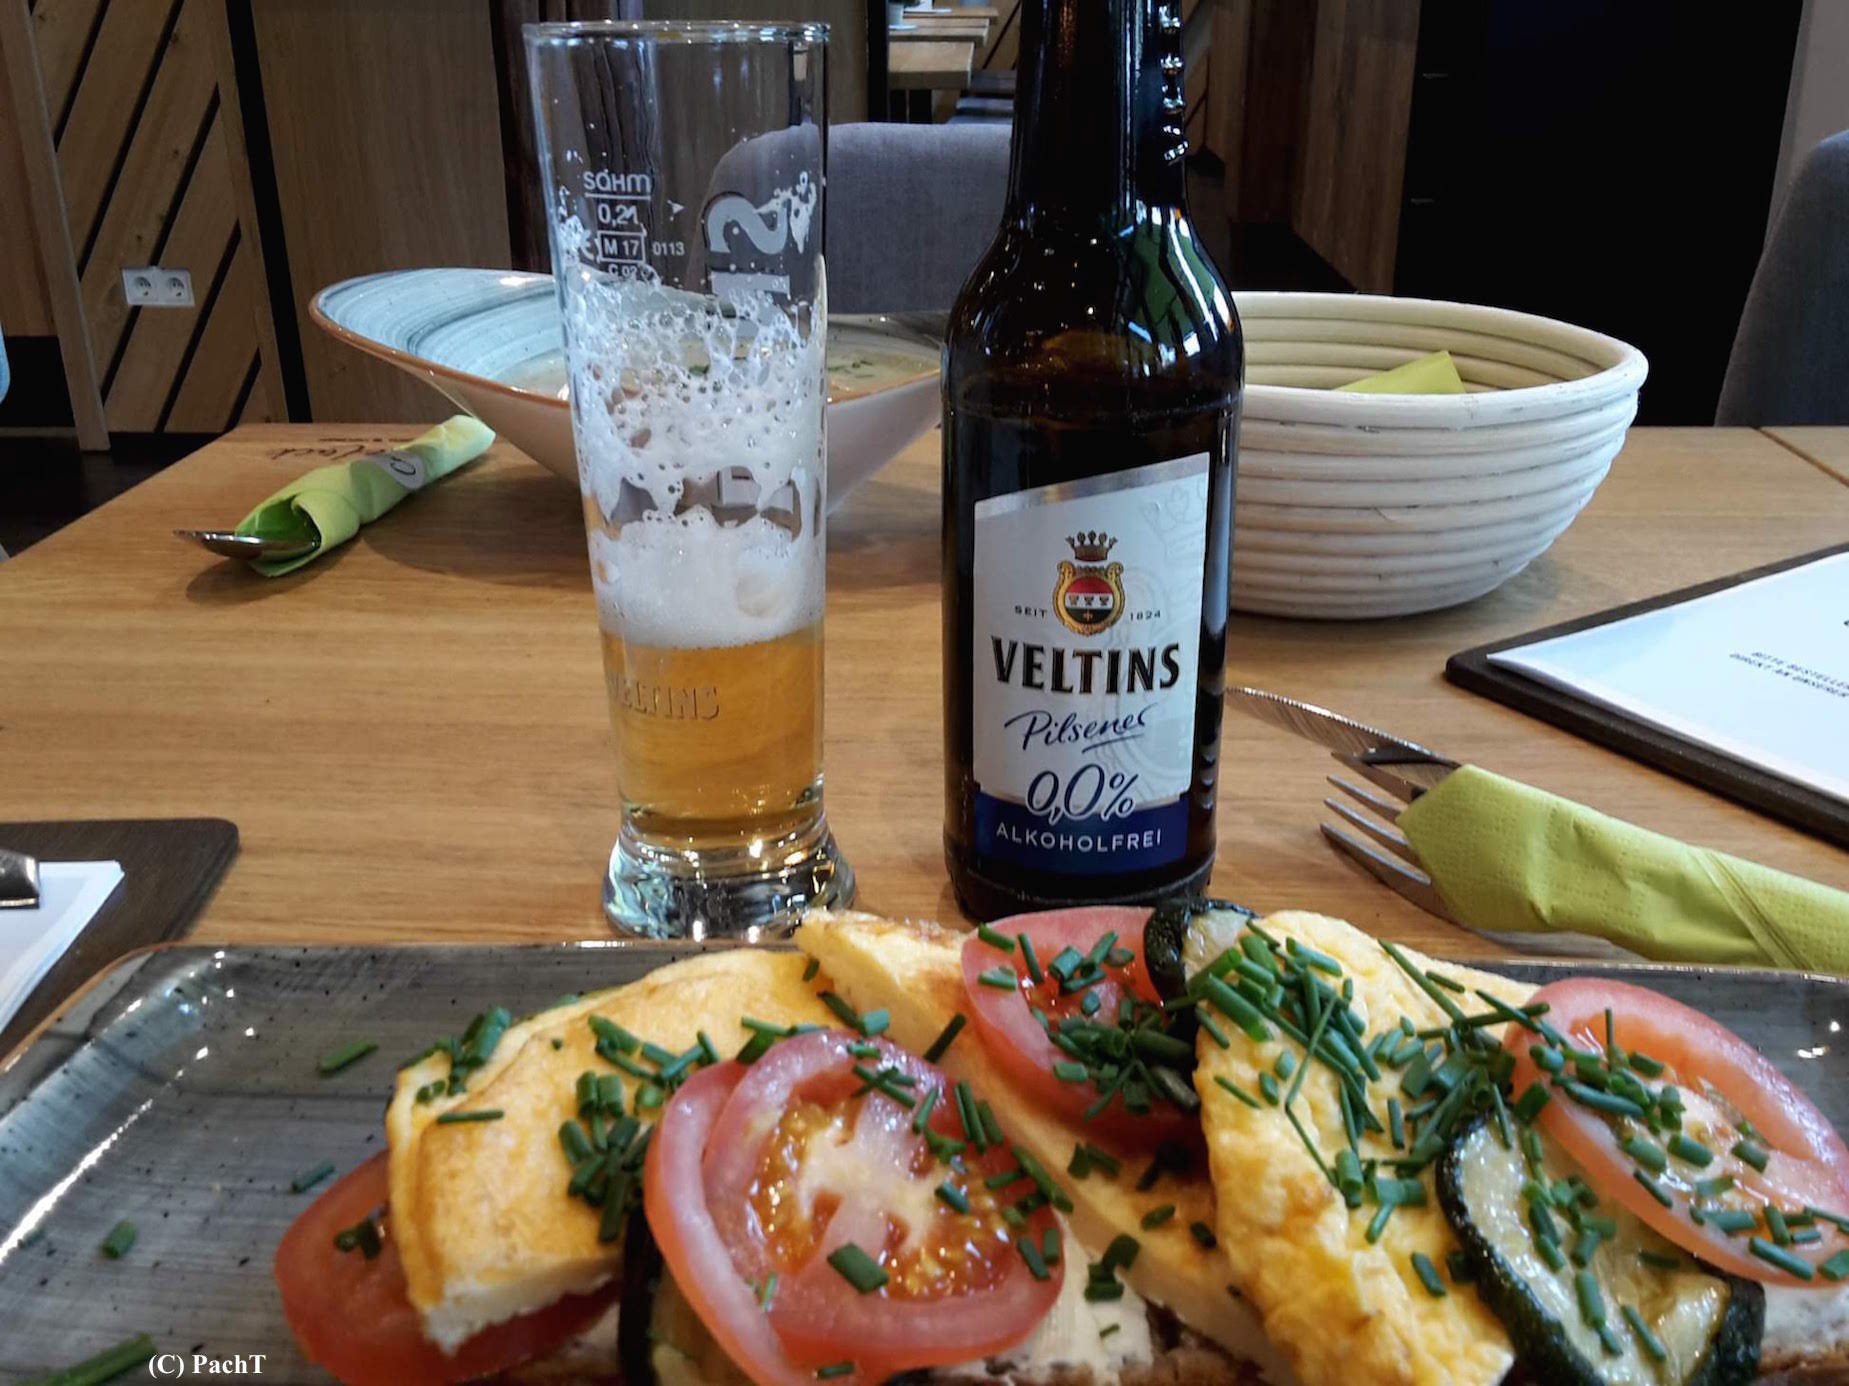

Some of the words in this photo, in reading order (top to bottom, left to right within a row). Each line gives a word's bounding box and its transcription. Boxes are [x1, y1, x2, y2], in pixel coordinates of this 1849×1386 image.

[604, 238, 618, 255] M
[622, 239, 641, 256] 17
[652, 241, 685, 257] 0113
[1014, 605, 1048, 619] SEIT
[1130, 610, 1161, 622] 1824
[991, 635, 1180, 695] VELTINS
[1004, 702, 1158, 752] Pilsener
[1027, 763, 1138, 825] 0,0%
[996, 822, 1162, 853] ALKOHOLFREI
